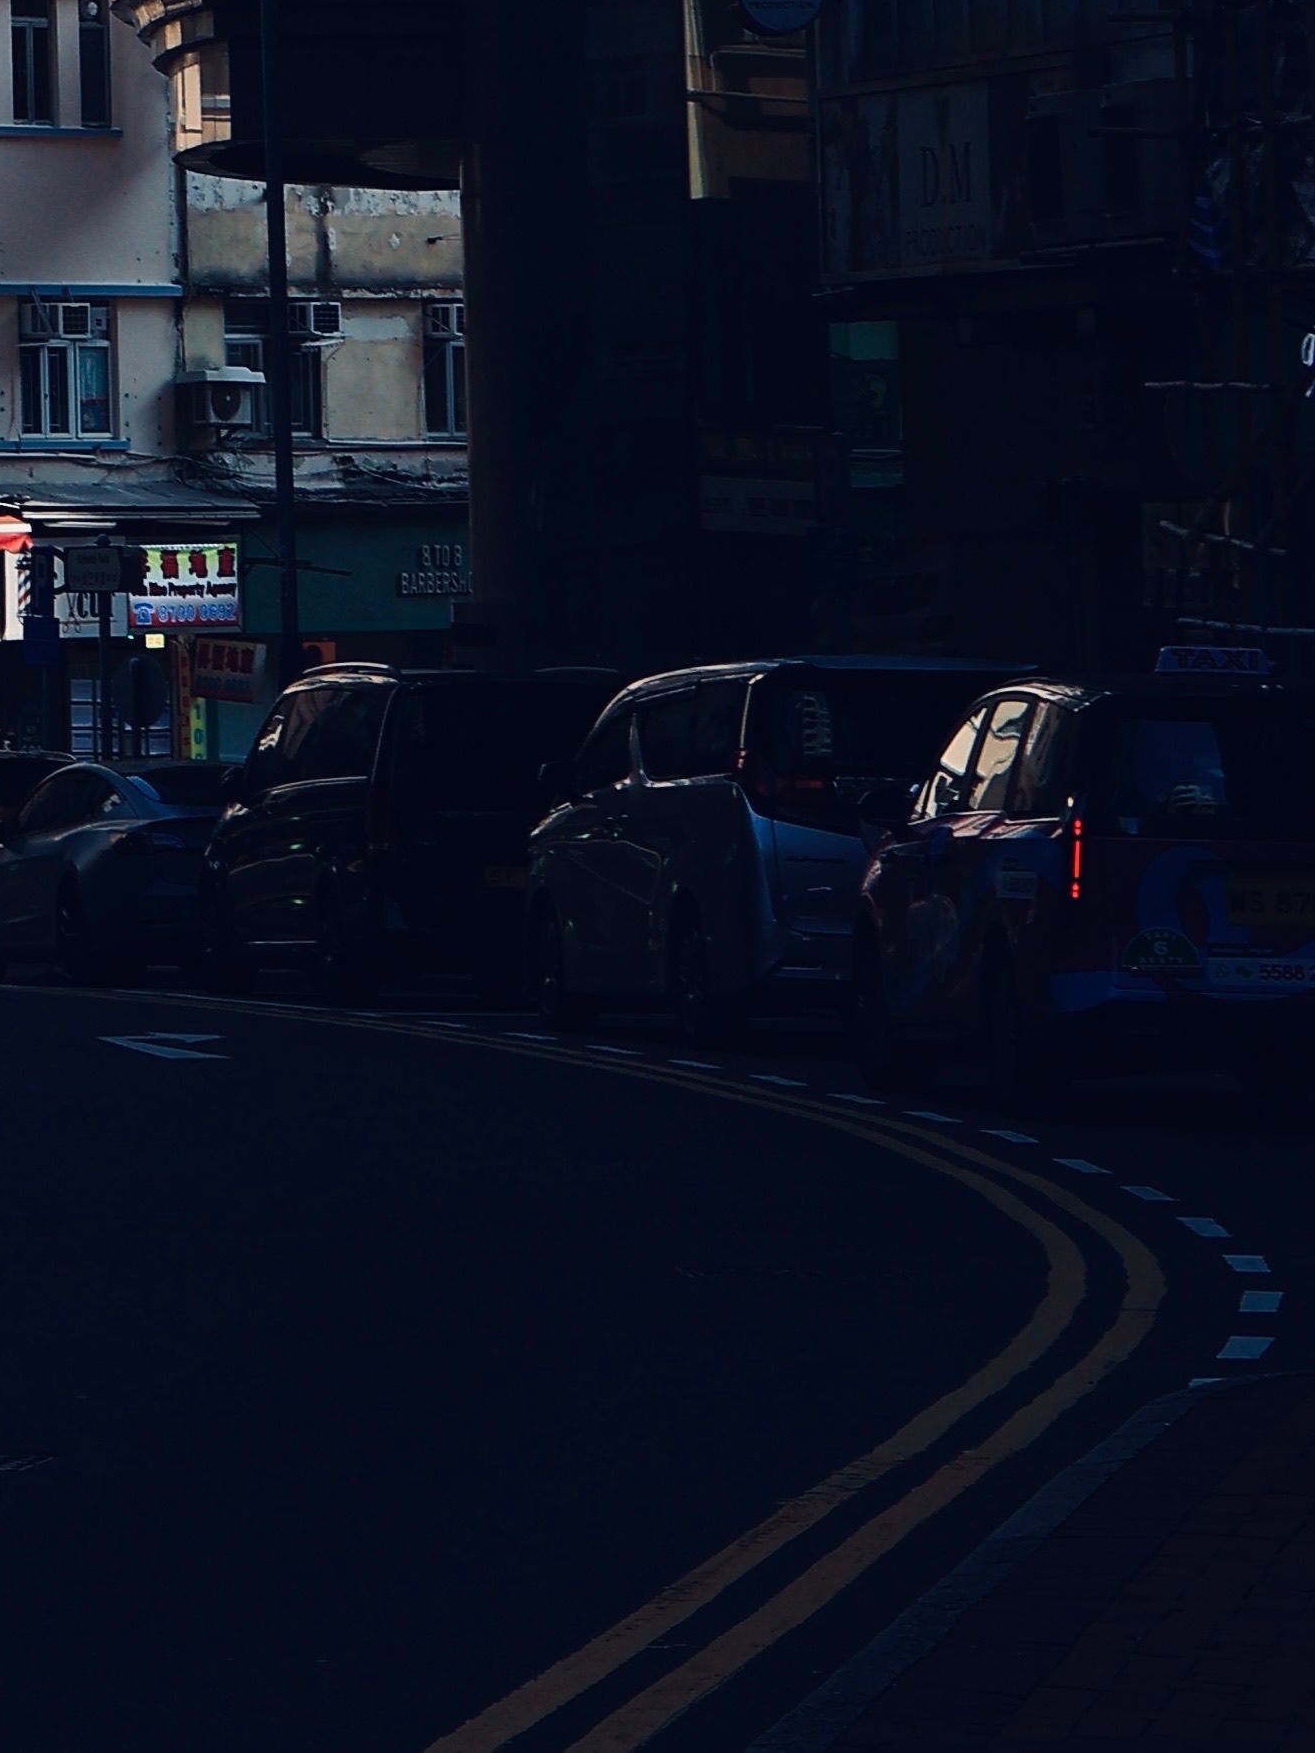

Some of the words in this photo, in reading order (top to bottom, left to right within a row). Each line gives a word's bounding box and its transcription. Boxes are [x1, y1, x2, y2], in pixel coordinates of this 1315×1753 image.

[422, 544, 432, 566] 8
[433, 544, 451, 567] TO
[453, 544, 463, 566] 8
[1170, 650, 1258, 671] TAXI
[1273, 890, 1315, 915] 87
[1153, 941, 1169, 956] 6
